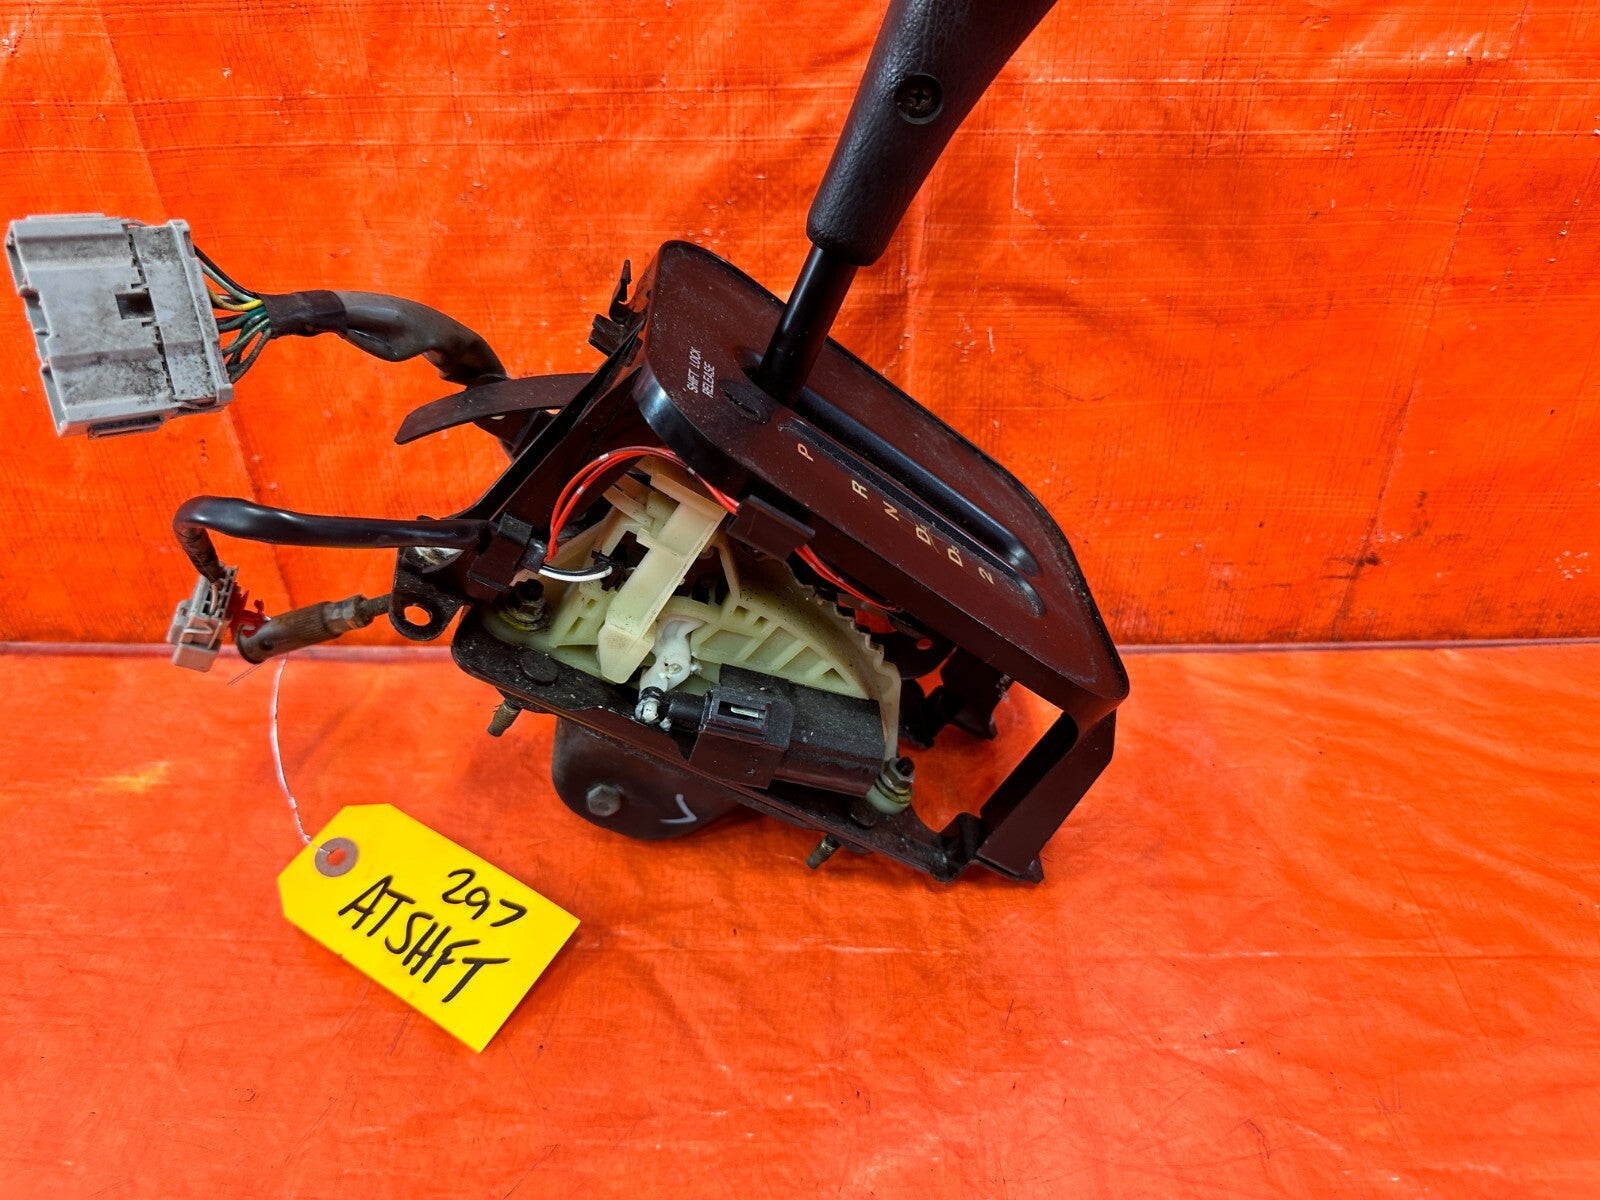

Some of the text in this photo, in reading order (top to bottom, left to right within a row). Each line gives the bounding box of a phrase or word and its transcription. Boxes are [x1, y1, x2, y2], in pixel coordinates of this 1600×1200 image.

[687, 345, 701, 394] SHIFT LOCK
[702, 361, 715, 399] RELEASE
[797, 443, 814, 461] P
[851, 480, 868, 500] R
[883, 501, 900, 521] N
[978, 566, 994, 584] 2
[442, 868, 528, 928] 297
